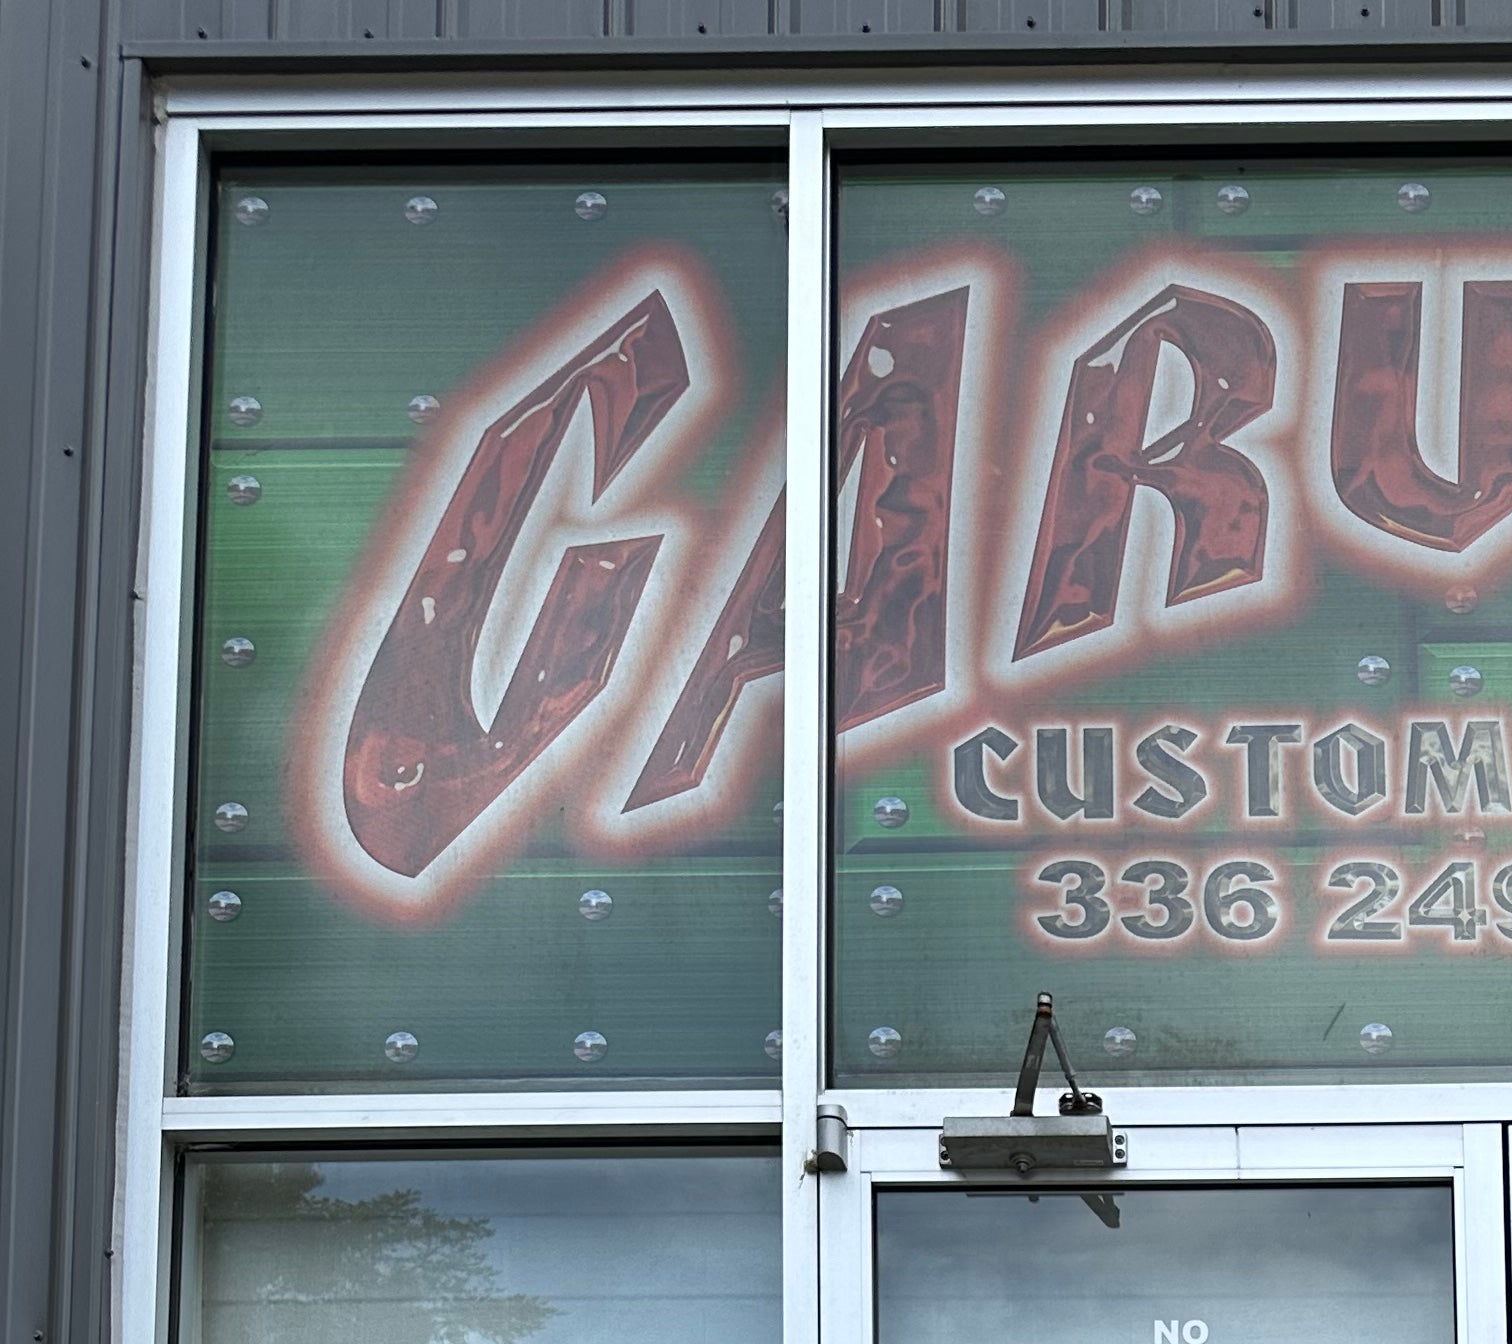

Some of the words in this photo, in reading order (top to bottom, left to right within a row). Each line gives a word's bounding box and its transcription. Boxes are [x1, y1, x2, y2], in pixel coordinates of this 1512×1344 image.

[952, 719, 1512, 822] CUSTOM
[1038, 860, 1276, 942] 336
[1154, 1319, 1209, 1344] NO
